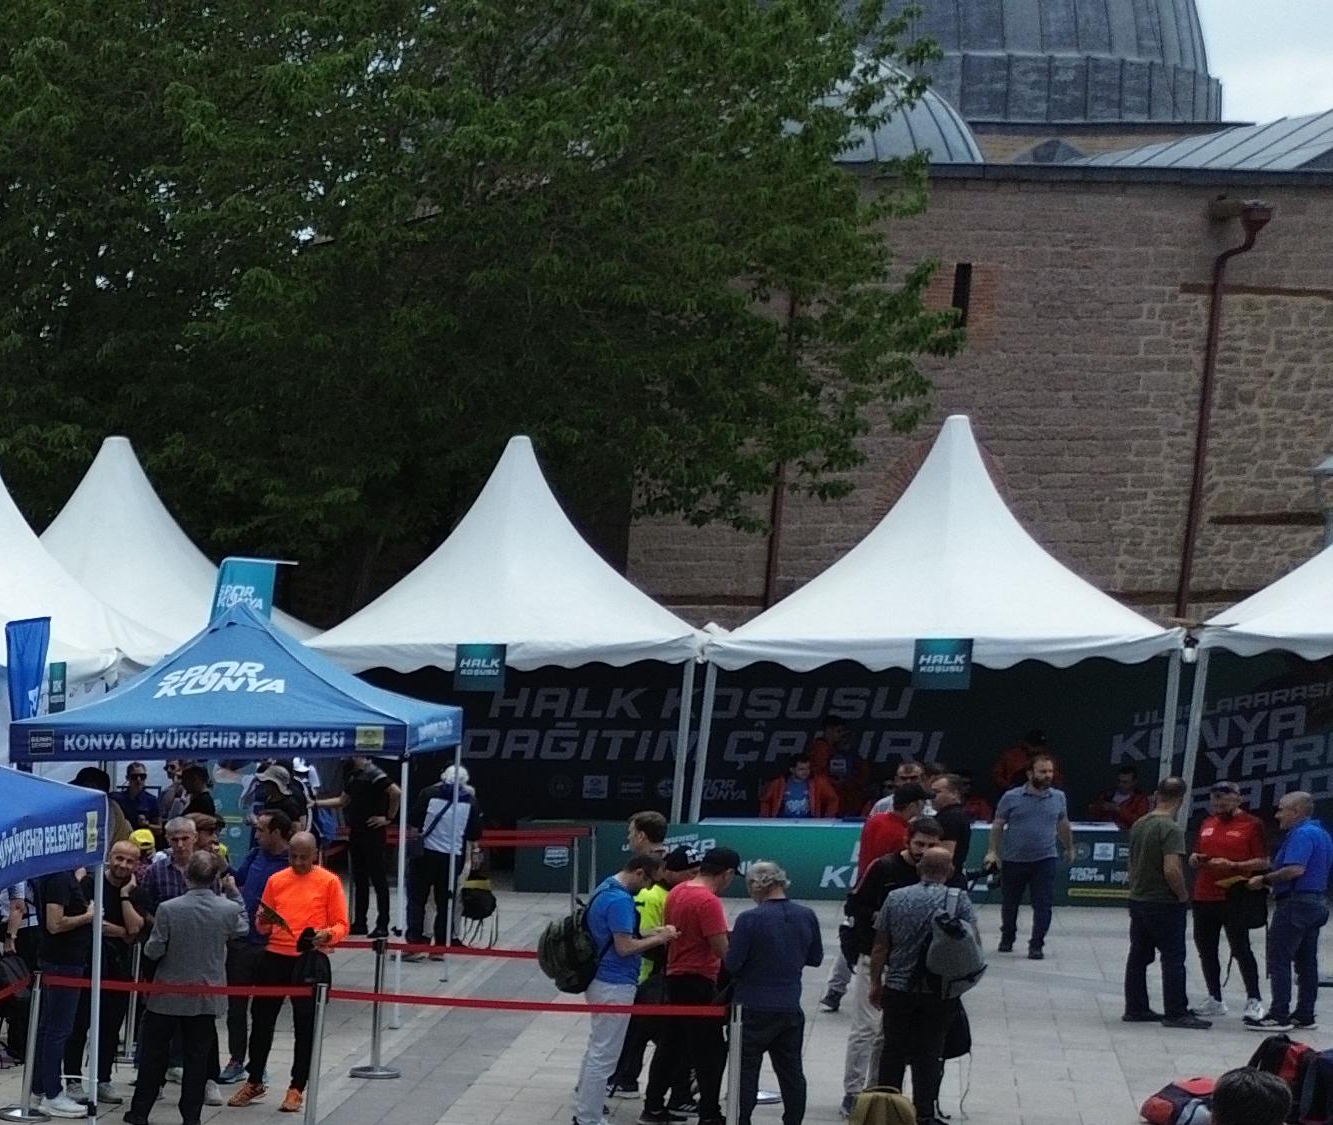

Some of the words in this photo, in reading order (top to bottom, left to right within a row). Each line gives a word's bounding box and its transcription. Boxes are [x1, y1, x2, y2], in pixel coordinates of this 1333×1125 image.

[459, 658, 501, 668] HALK
[919, 653, 965, 665] HALK
[162, 661, 266, 685] SPOR
[154, 672, 285, 699] KONYA
[487, 686, 650, 720] HALK
[63, 733, 126, 750] KONYA
[130, 728, 239, 753] BÜYÜKŞEHİR
[244, 729, 345, 749] BELEDİYESİ
